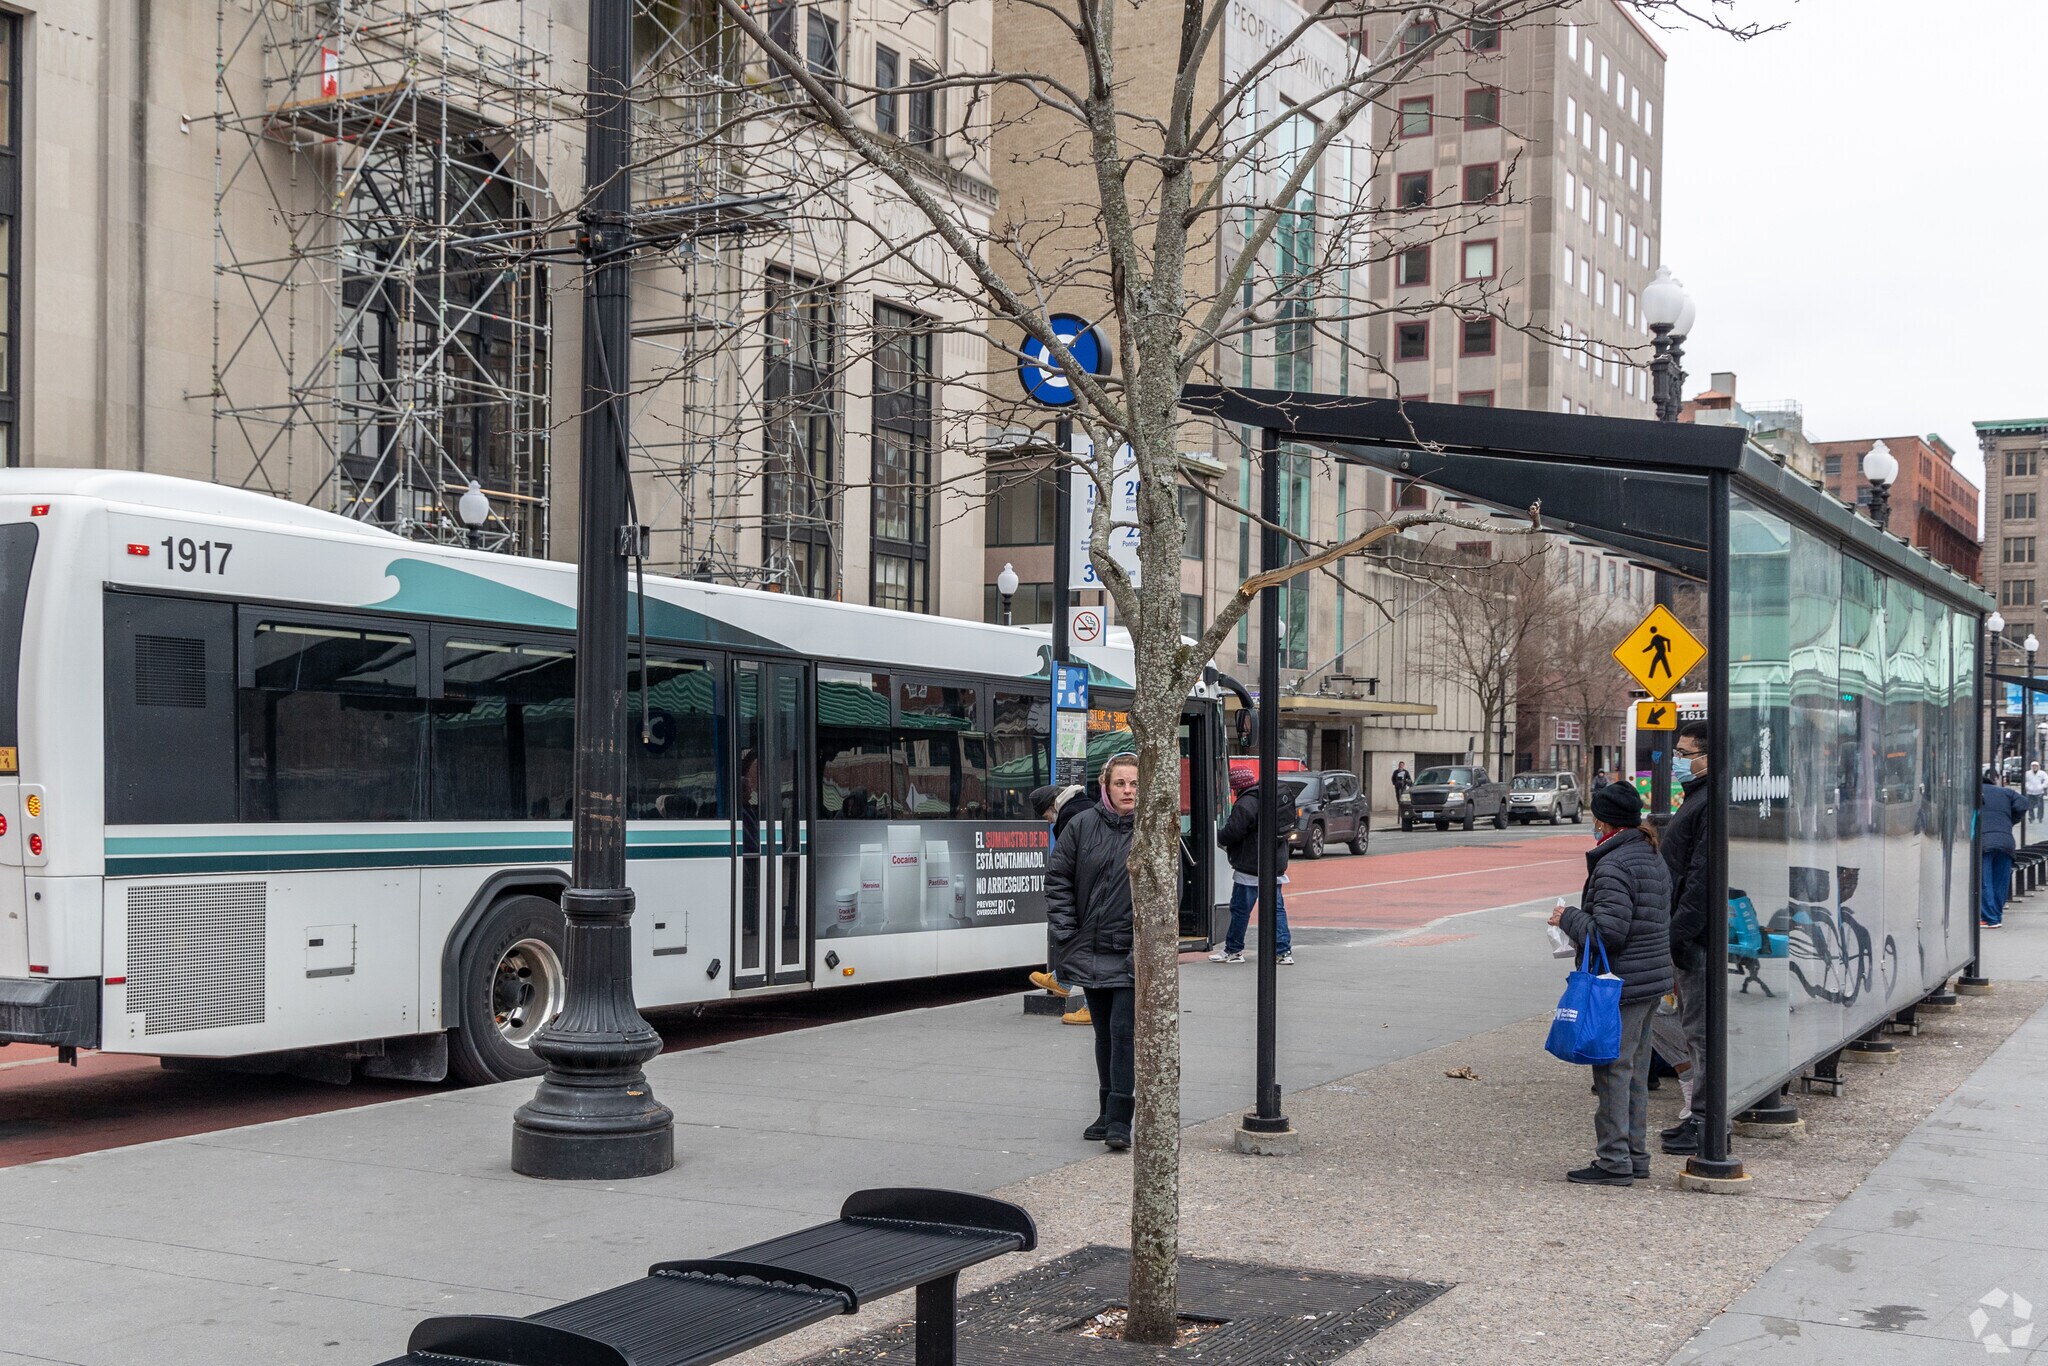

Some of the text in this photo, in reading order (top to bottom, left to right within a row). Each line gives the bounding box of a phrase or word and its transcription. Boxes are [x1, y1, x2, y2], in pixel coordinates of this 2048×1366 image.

[1290, 43, 1336, 91] SAVINGS
[160, 535, 233, 576] 1917
[1089, 709, 1106, 721] STOP
[1113, 711, 1128, 723] SHO
[1680, 710, 1708, 721] 1611
[975, 831, 1049, 849] EL SUMINISTRO DE DR
[892, 854, 918, 865] Cocaína
[976, 848, 1045, 870] ESTÁ CONTAMINADO.
[928, 879, 949, 887] Pastillas
[976, 877, 987, 895] NO
[987, 876, 1030, 895] ARRIESGUES
[1030, 875, 1040, 893] TU
[976, 899, 998, 909] PREVENT
[998, 899, 1006, 915] RI
[976, 908, 998, 916] OVERDOSE
